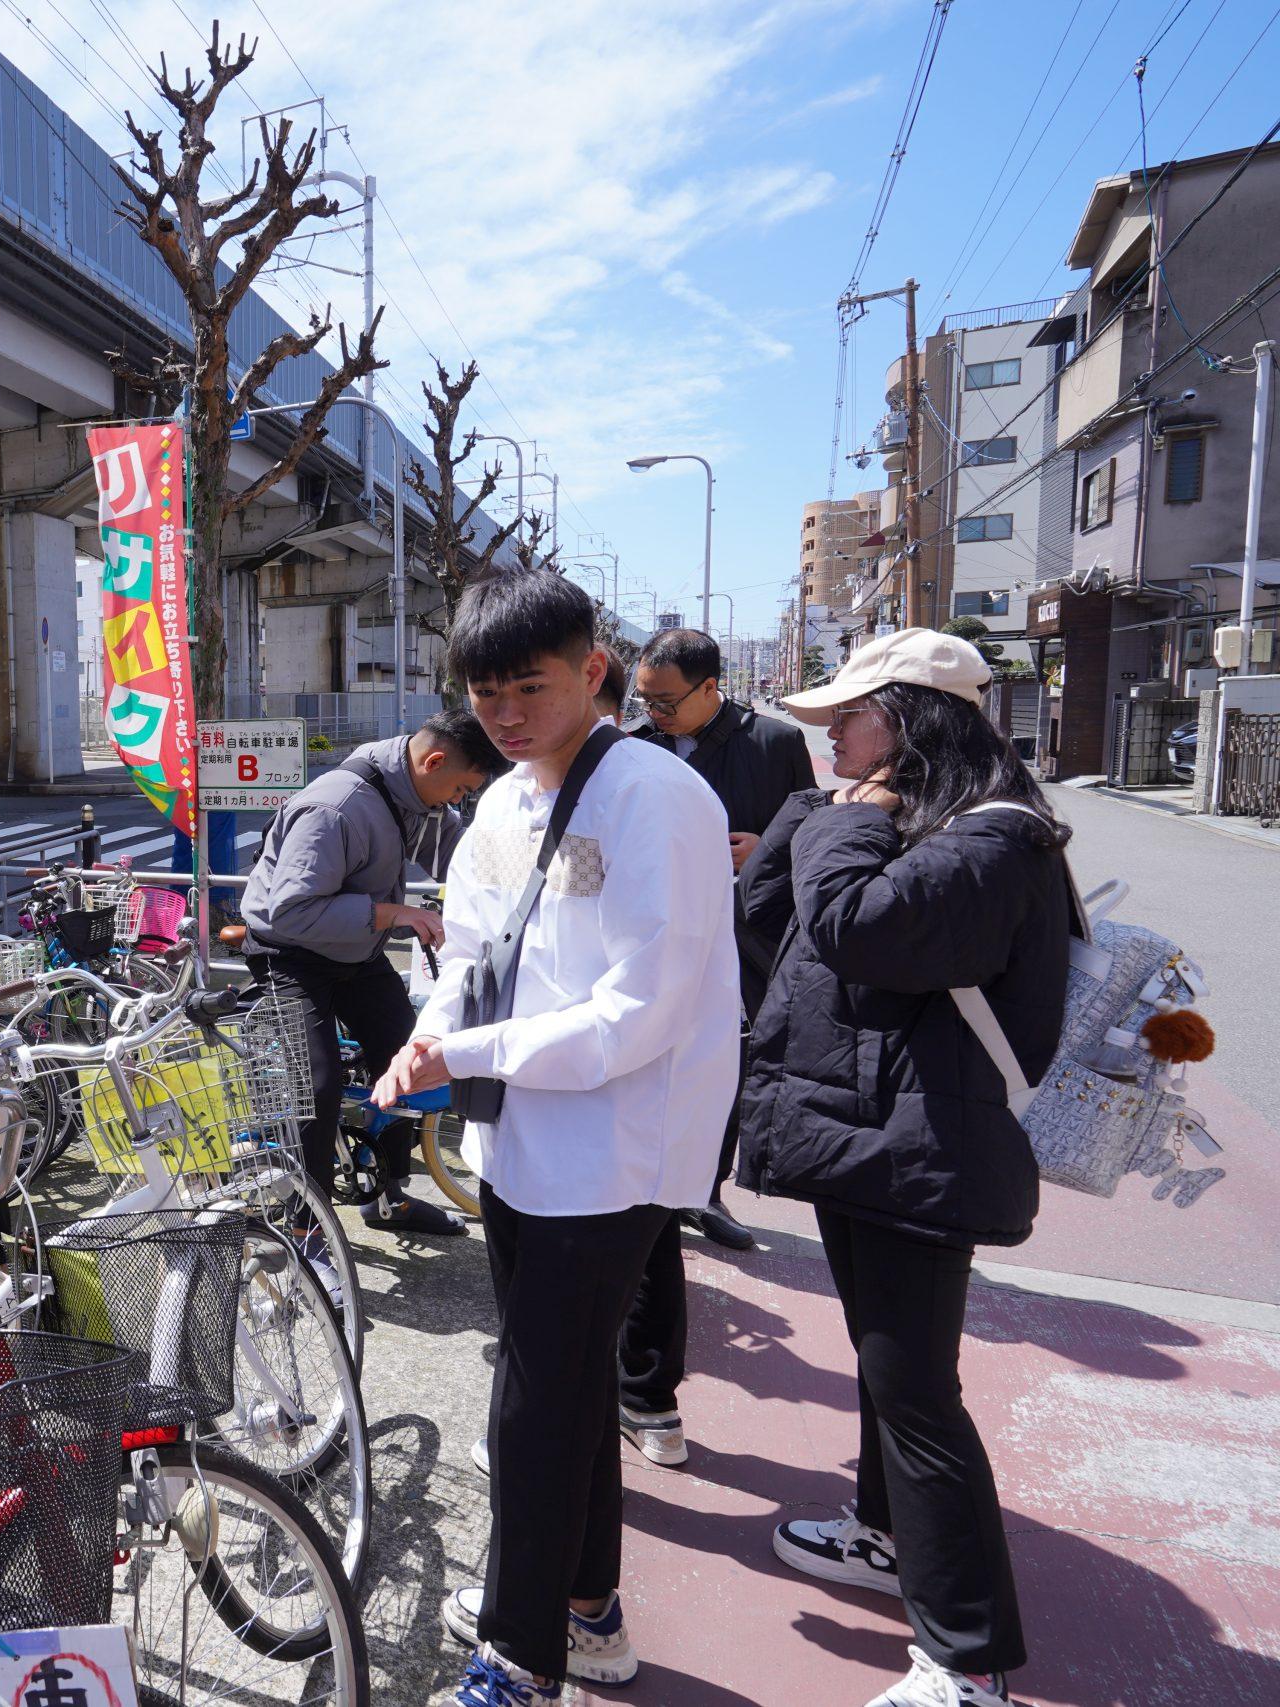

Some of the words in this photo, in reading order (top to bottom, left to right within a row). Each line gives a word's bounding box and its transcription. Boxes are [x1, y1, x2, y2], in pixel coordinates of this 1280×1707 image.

[159, 523, 191, 753] お気軽にお立ち寄り下さい
[237, 754, 259, 781] B
[265, 773, 300, 783] ブロック
